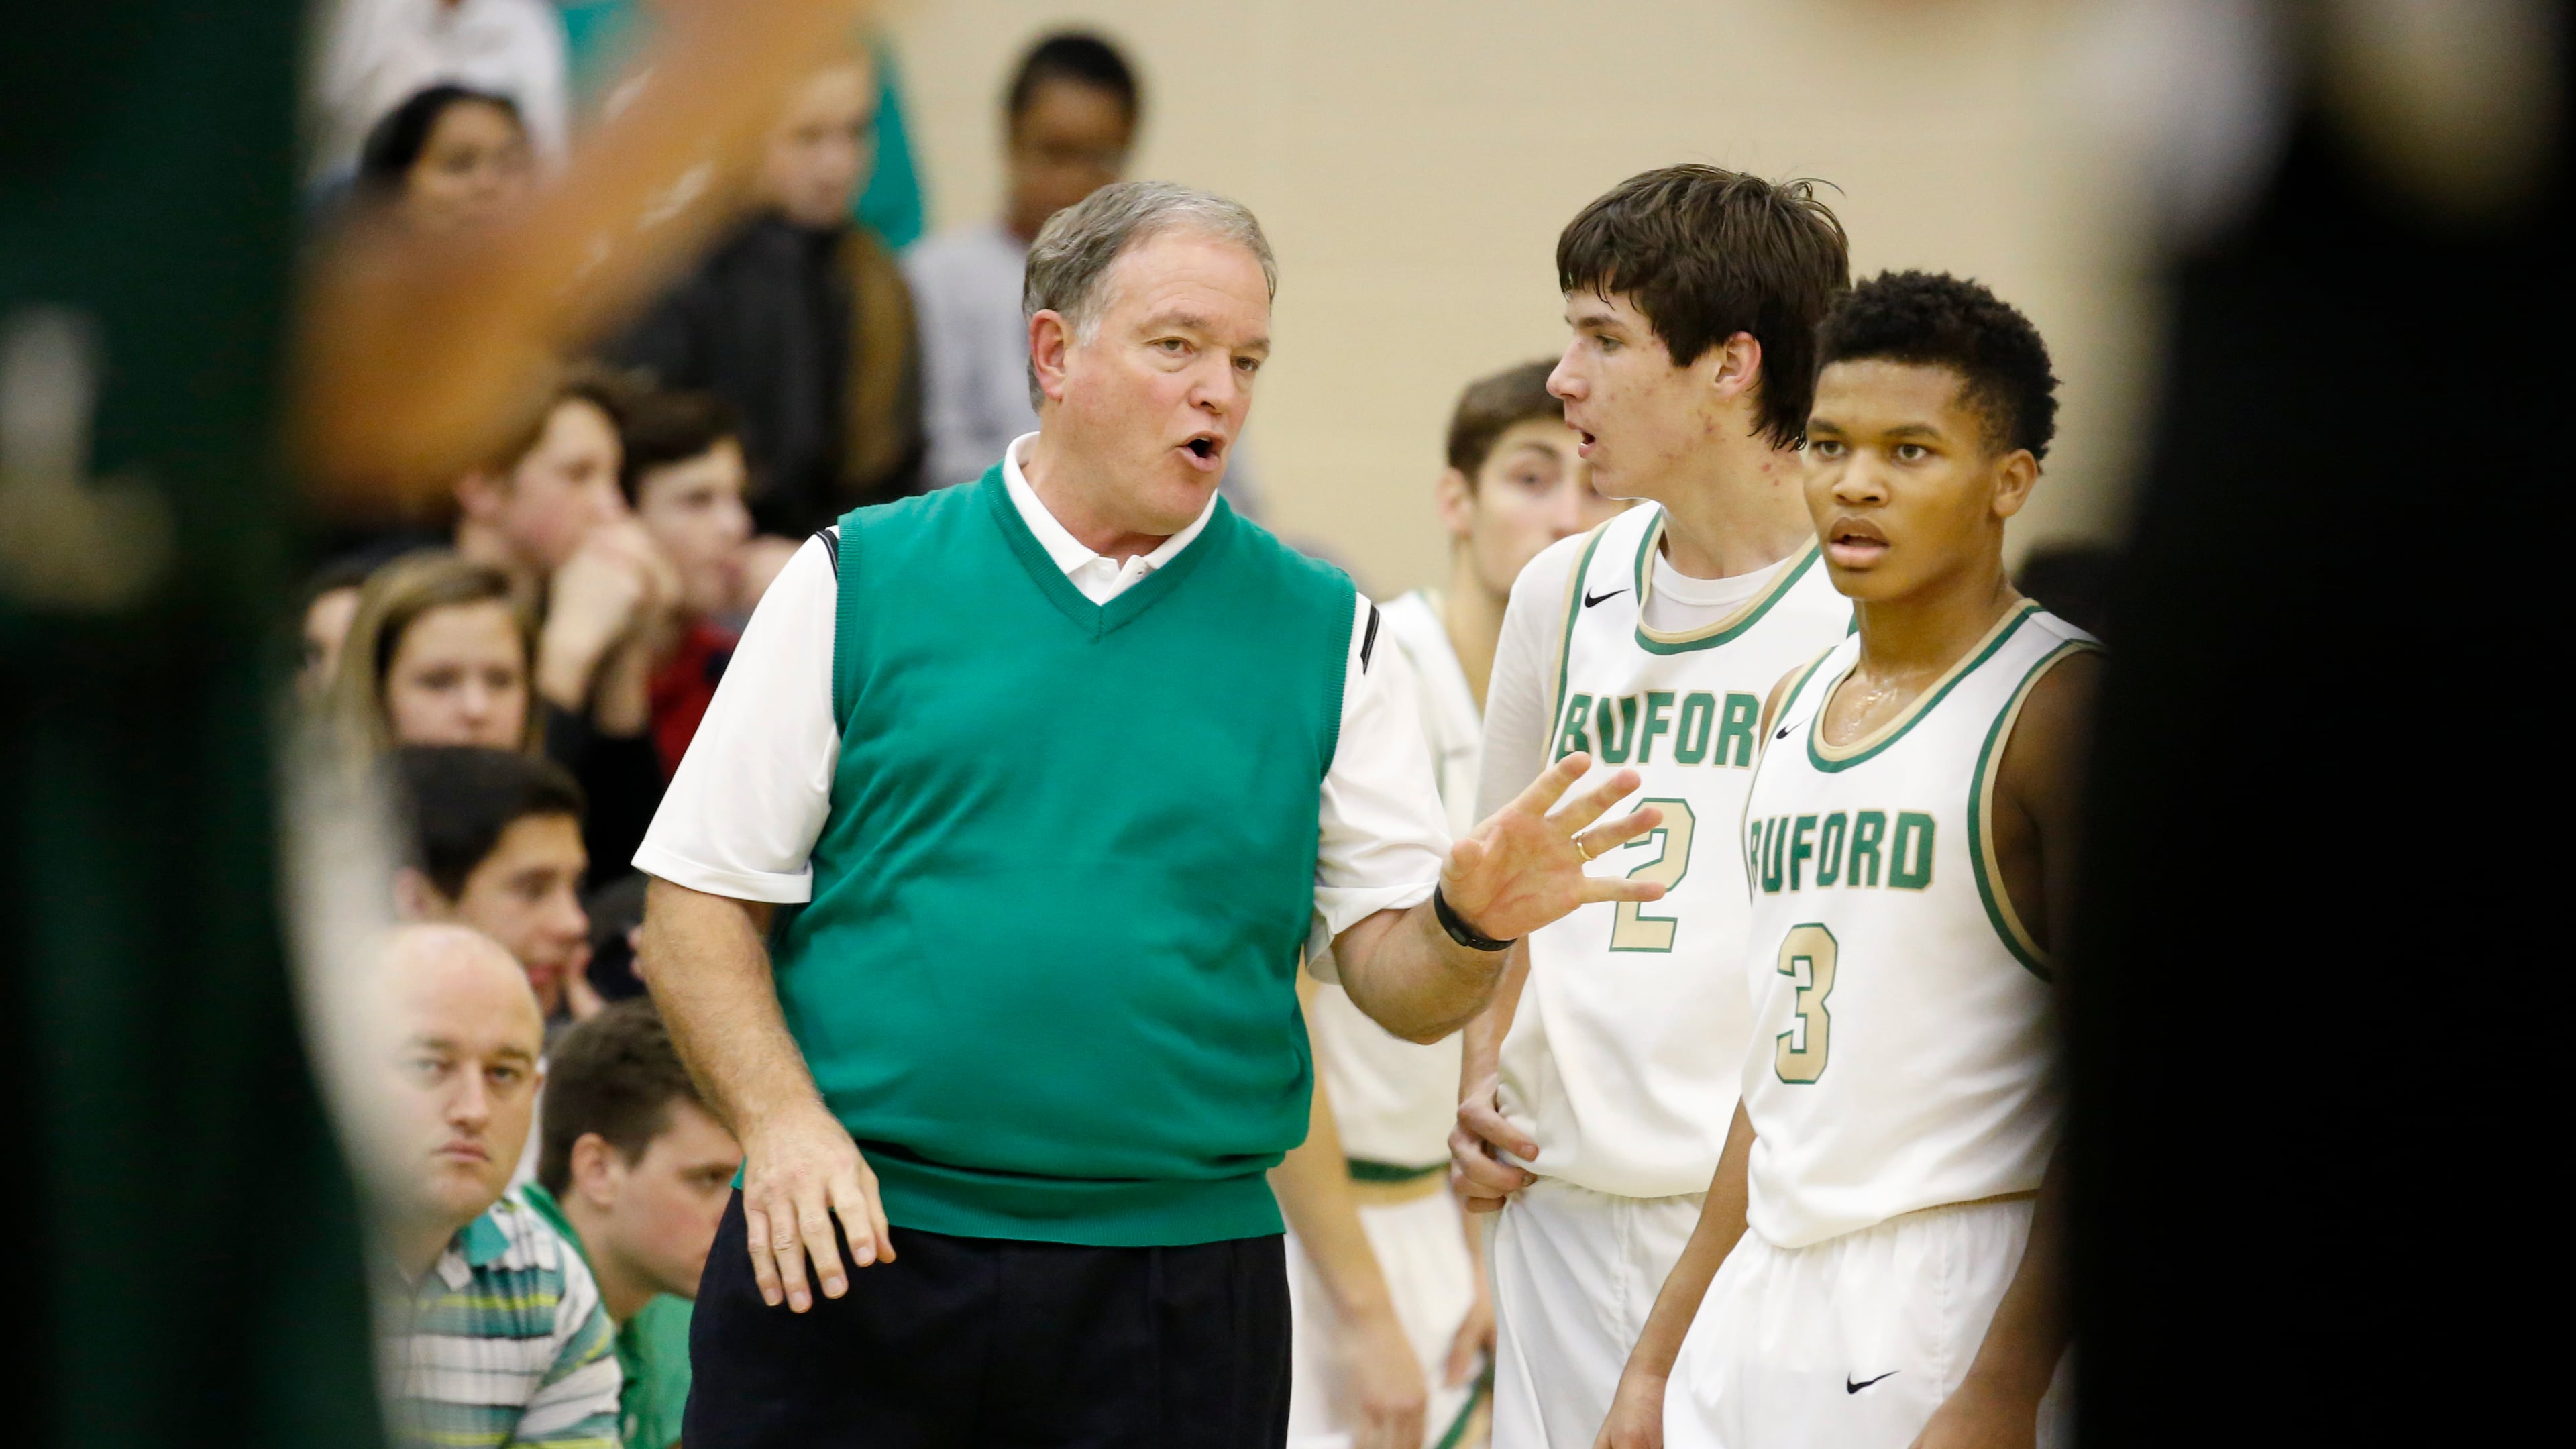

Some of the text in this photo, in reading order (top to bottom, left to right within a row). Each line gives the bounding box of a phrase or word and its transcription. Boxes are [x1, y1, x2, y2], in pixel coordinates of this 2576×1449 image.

[1554, 690, 1762, 770] BUFOR
[1609, 797, 1695, 953] 2
[1750, 808, 1937, 894] BUFORD
[1774, 922, 1839, 1085] 3
